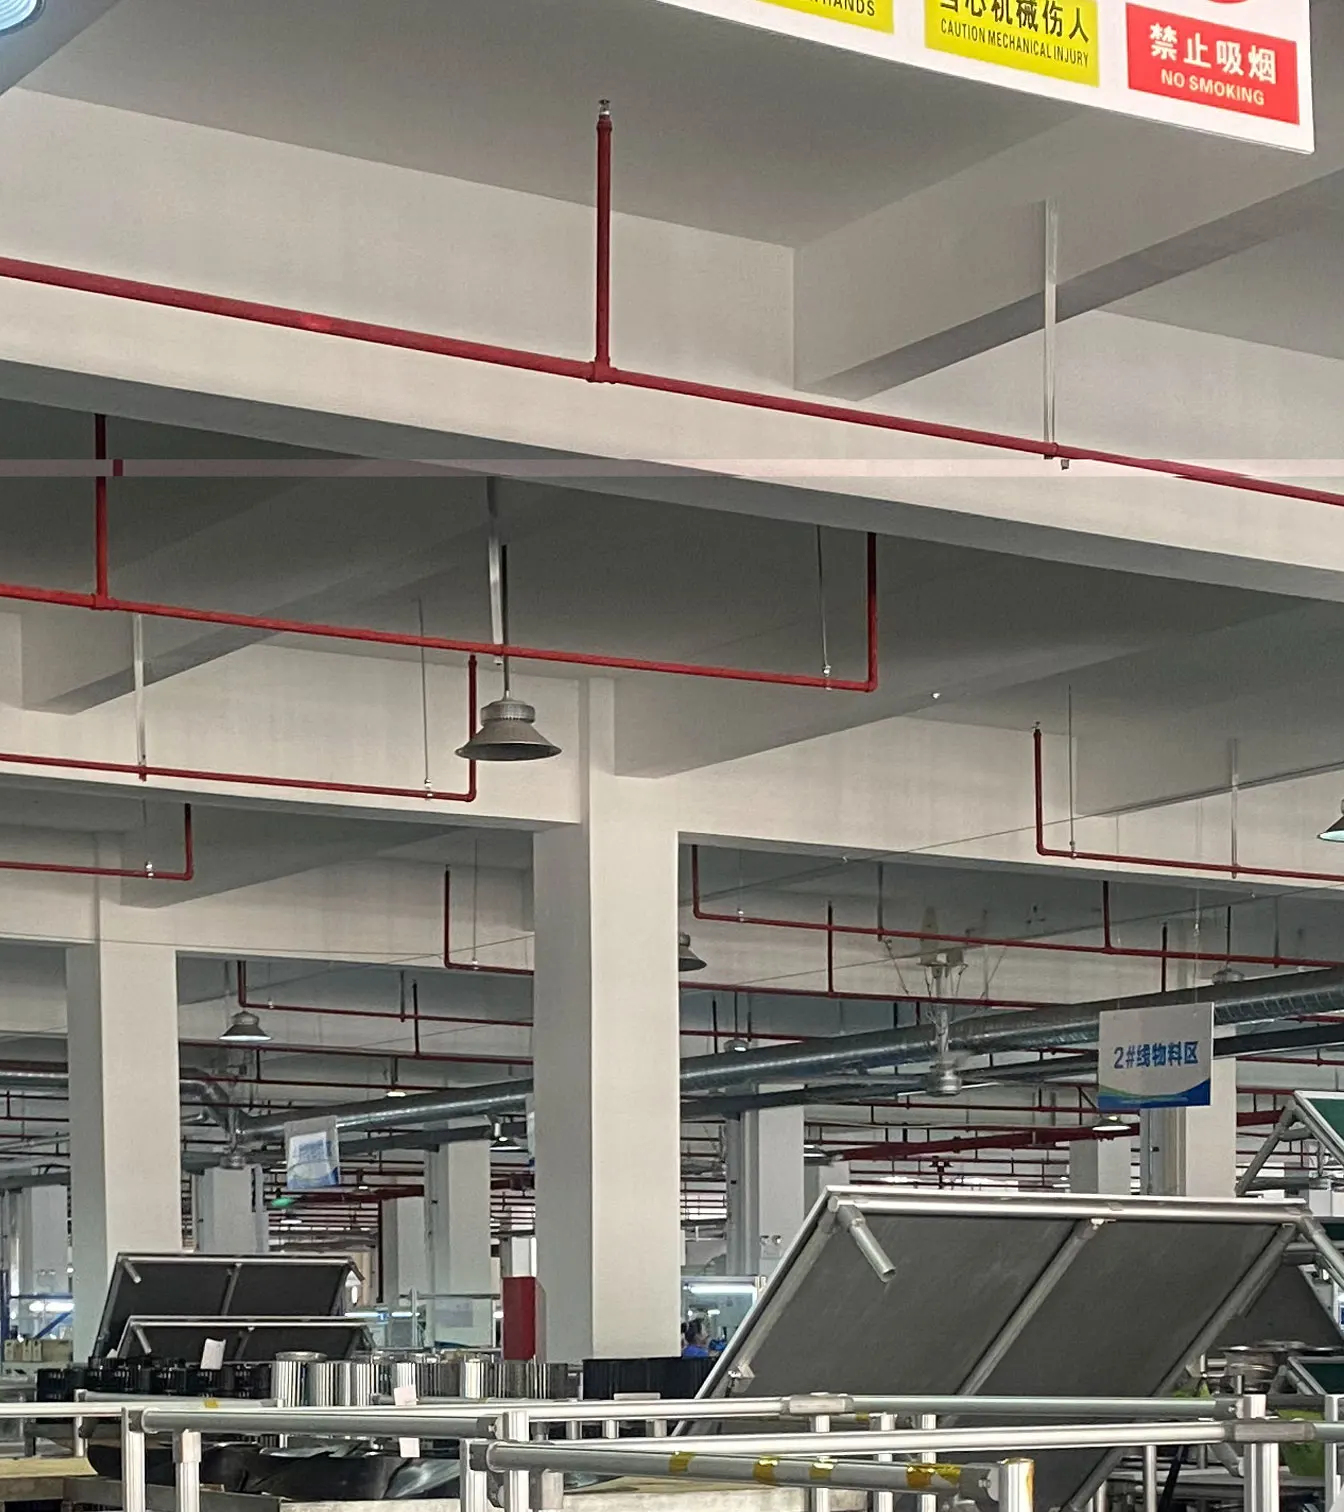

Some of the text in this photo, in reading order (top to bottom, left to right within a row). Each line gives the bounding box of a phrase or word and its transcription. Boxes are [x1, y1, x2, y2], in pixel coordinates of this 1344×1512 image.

[940, 18, 1089, 67] CAUTION MECHANICAL INJURY
[1150, 23, 1277, 84] 禁止吸烟
[1161, 69, 1265, 105] NO SMOKING
[1113, 1041, 1199, 1069] 2#线物料区
